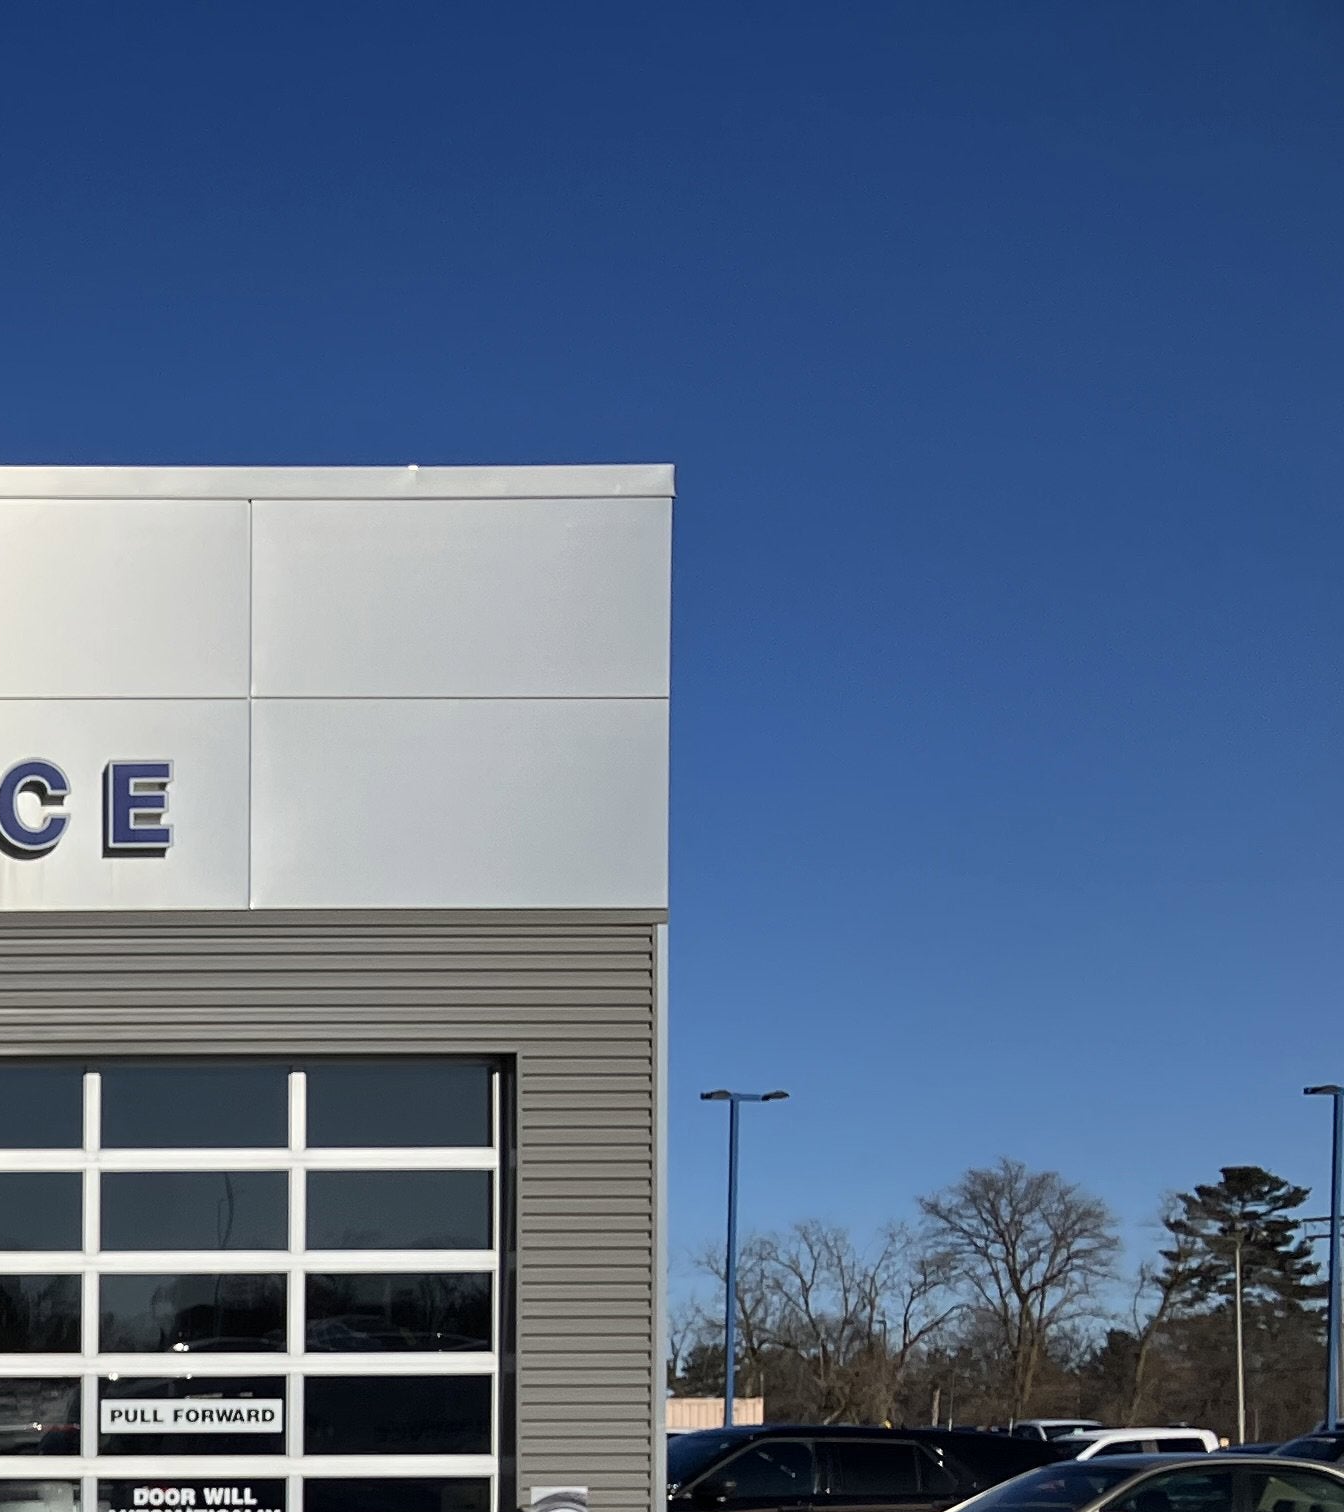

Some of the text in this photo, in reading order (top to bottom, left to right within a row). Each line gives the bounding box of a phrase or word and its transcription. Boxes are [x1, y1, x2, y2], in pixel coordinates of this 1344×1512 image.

[111, 1409, 275, 1423] PULL FORWARD
[133, 1487, 258, 1505] DOOR WILL
